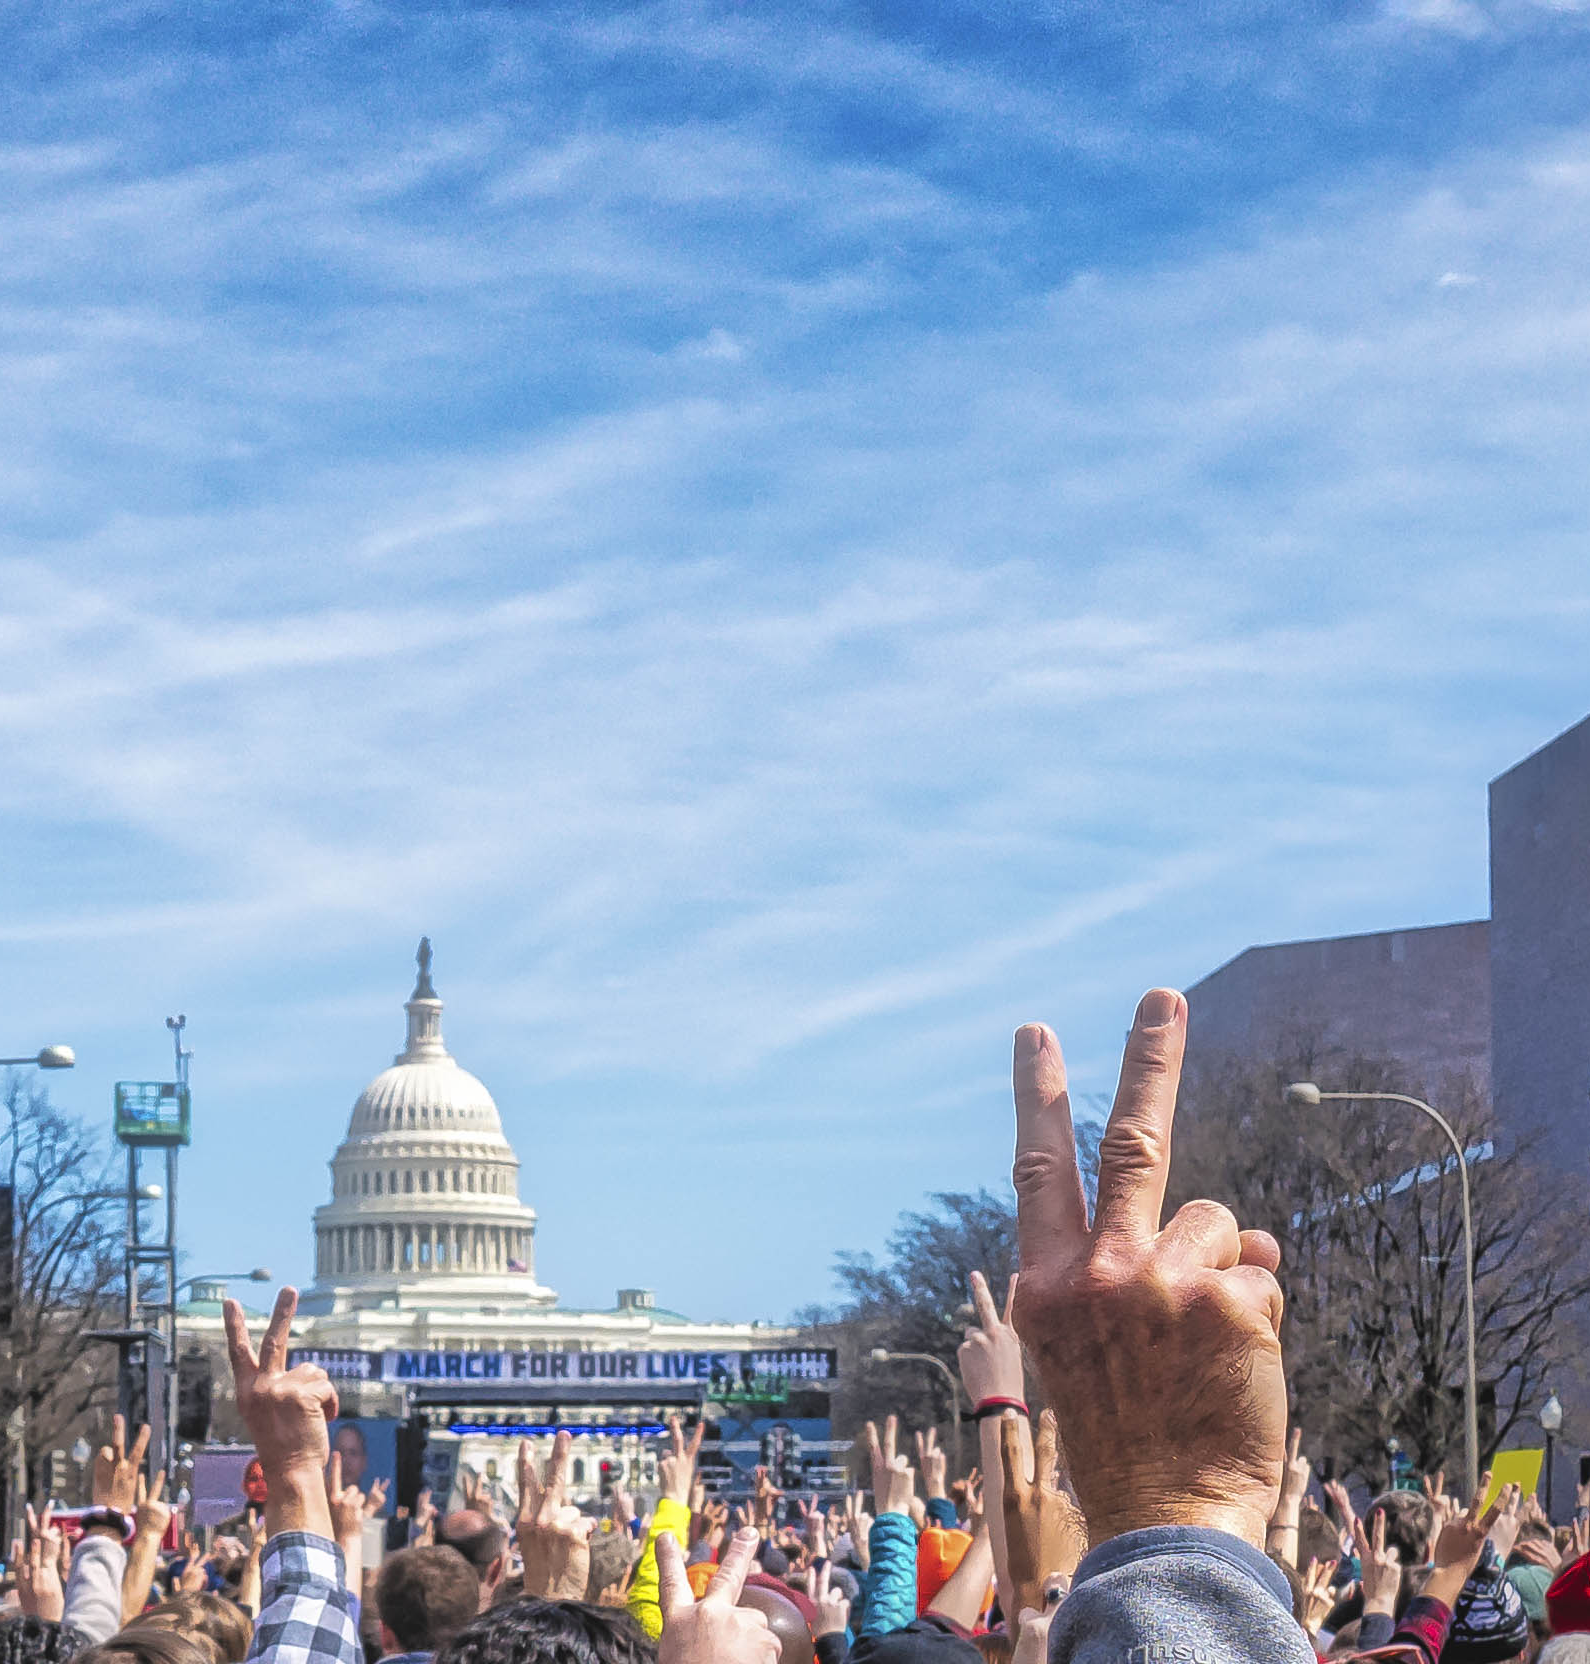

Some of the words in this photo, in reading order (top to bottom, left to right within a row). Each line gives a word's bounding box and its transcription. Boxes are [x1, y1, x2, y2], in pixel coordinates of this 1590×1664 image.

[397, 1354, 501, 1378] MARCH
[514, 1354, 569, 1378] FOR
[579, 1354, 638, 1378] OUR
[647, 1354, 726, 1378] LIVES
